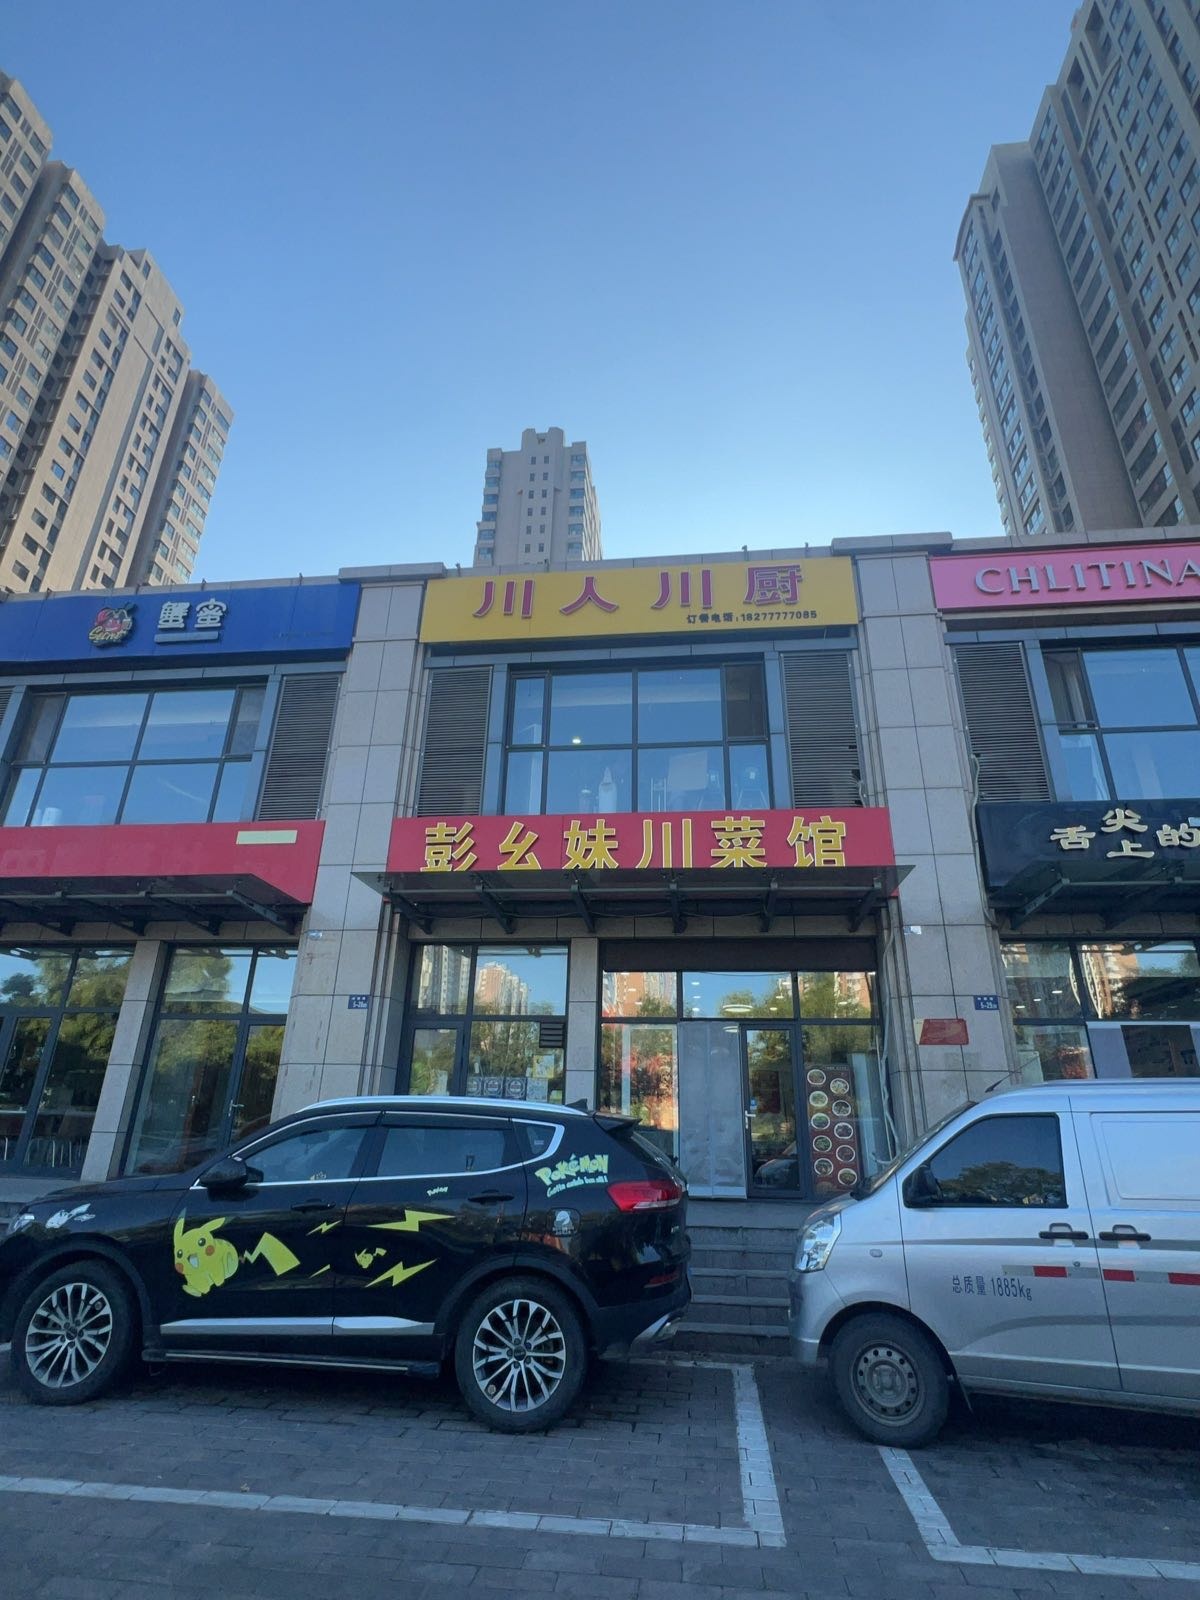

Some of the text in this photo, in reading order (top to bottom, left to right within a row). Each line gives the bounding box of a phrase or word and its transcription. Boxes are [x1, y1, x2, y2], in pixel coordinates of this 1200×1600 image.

[472, 564, 803, 619] 川人川厨
[975, 559, 1200, 595] CHLITINA
[420, 815, 848, 872] 彭幺妹川菜馆
[952, 1275, 1032, 1301] 总质量 1885kg
